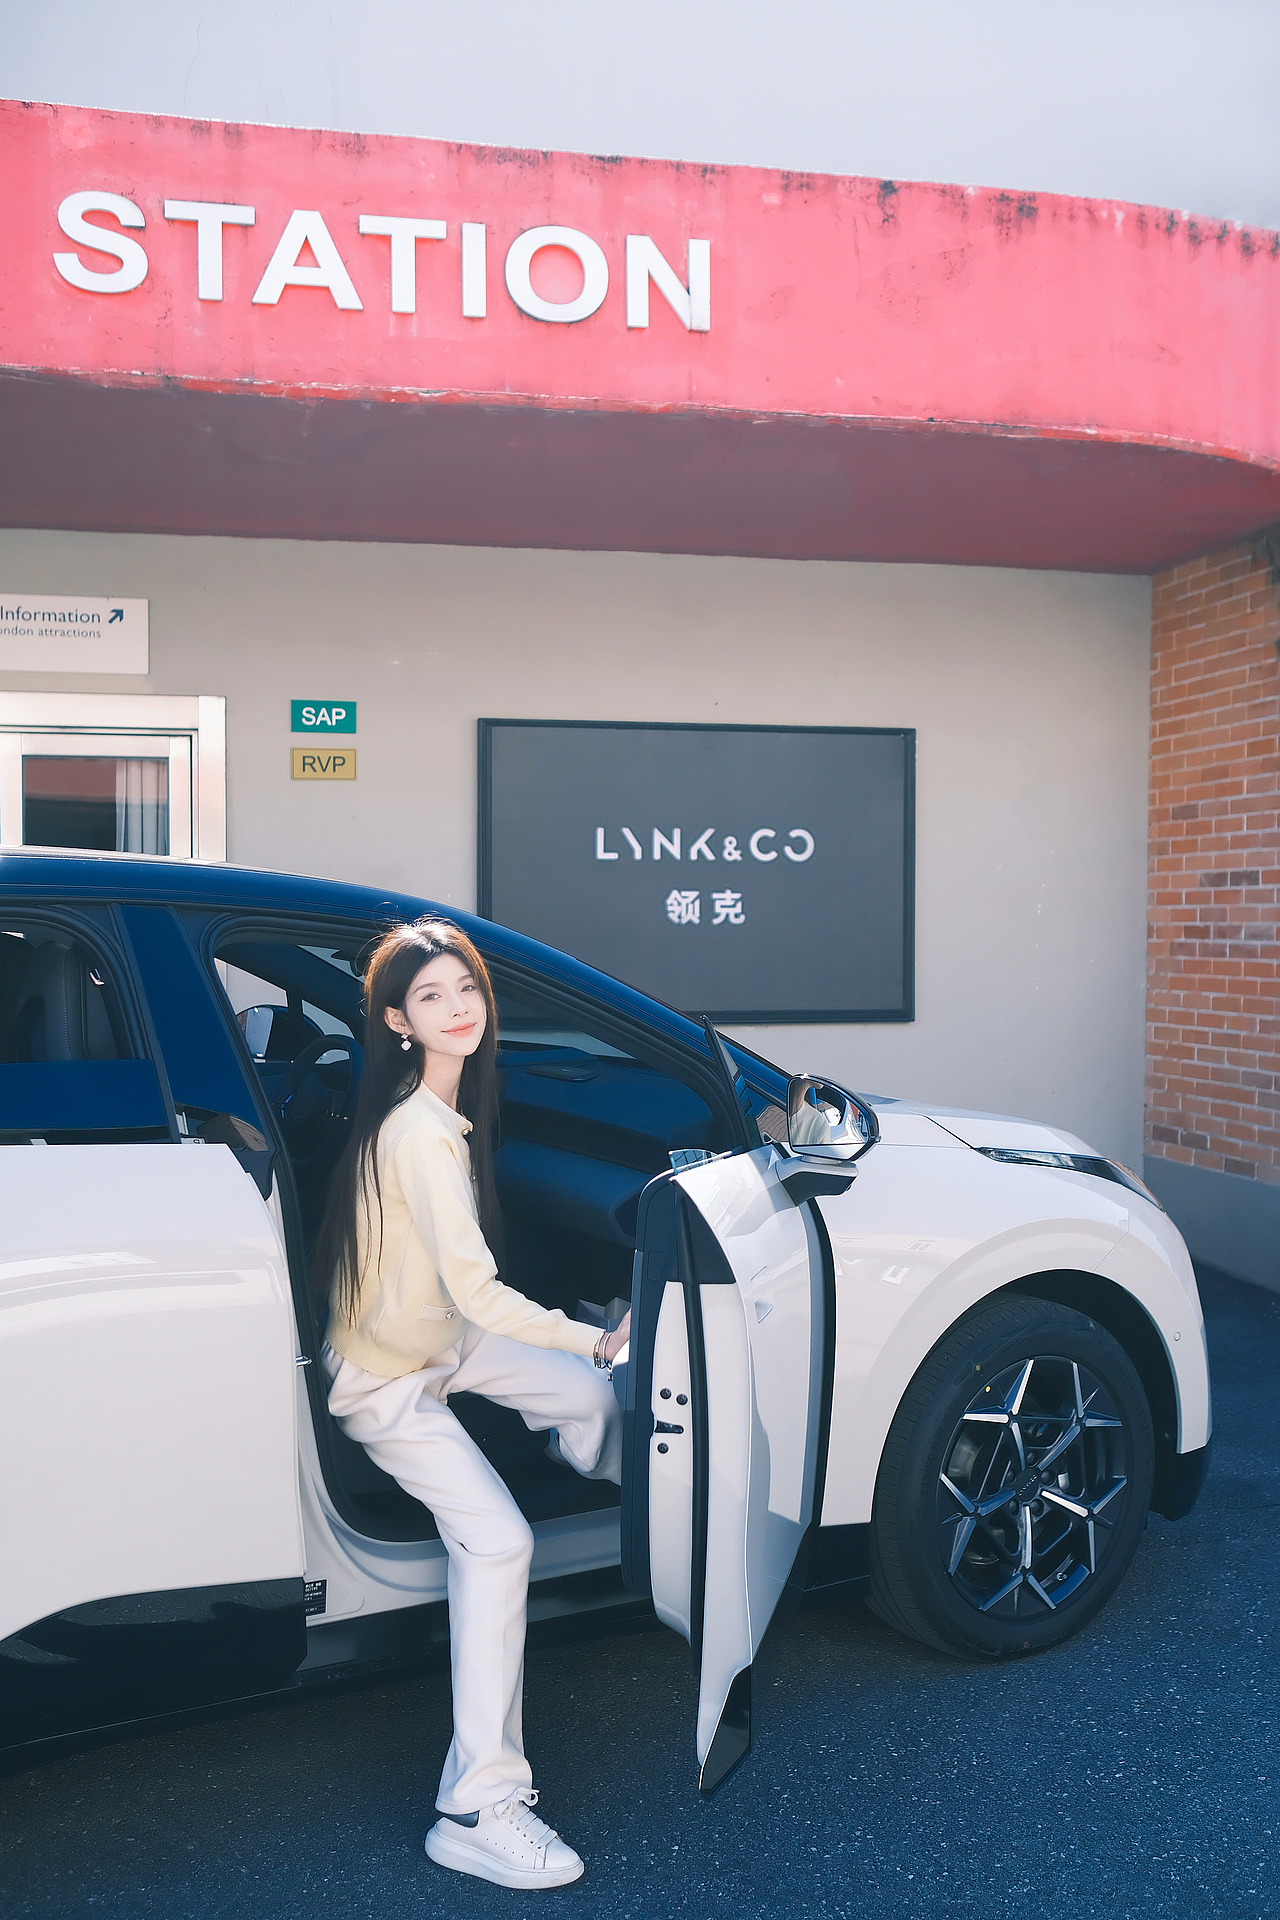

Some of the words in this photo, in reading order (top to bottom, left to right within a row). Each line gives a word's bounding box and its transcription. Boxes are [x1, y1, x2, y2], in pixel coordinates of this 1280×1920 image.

[53, 190, 711, 333] STATION
[0, 605, 101, 623] Information
[38, 627, 102, 638] attractions
[301, 706, 346, 726] SAP
[302, 755, 346, 773] RVP
[666, 889, 745, 924] 领克
